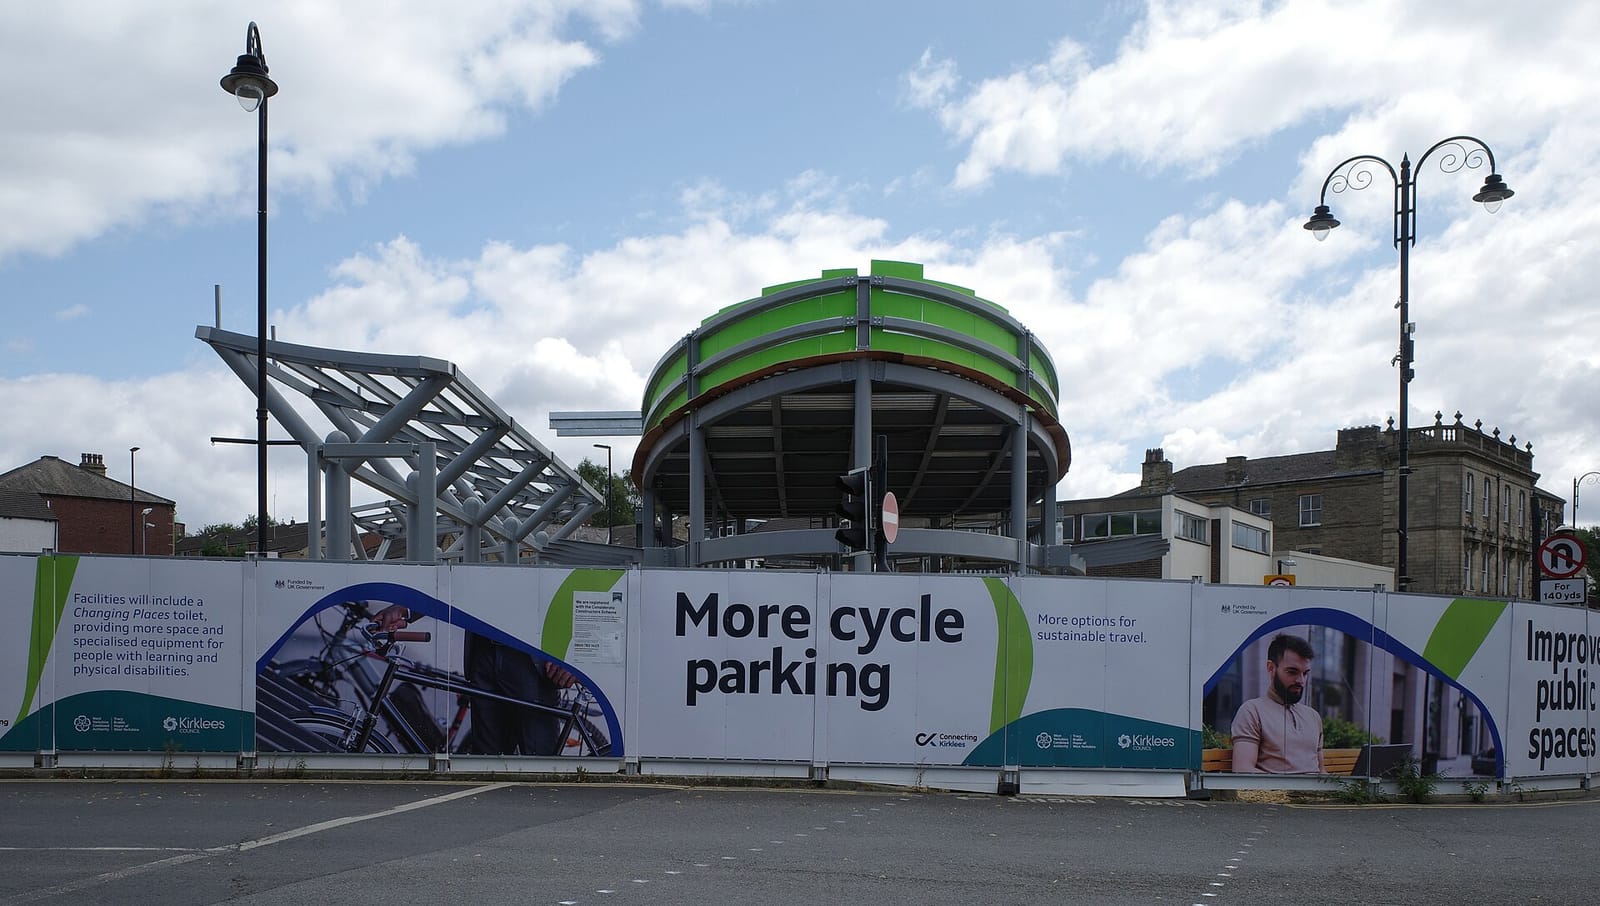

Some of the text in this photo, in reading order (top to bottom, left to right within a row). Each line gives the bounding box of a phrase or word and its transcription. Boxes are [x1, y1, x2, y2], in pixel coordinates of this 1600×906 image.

[74, 593, 204, 607] Facilities will include a
[1544, 592, 1581, 600] 140 yds
[73, 607, 207, 622] Changing Places toilet,
[1038, 614, 1137, 628] More options for
[73, 622, 224, 636] providing more space and
[675, 592, 965, 655] More cycle
[73, 636, 224, 650] specialised equipment for
[1037, 630, 1147, 643] sustainable travel.
[73, 650, 218, 665] people with learning and
[73, 664, 189, 676] physical disabilities.
[686, 646, 891, 712] parking
[1536, 667, 1596, 722] public
[179, 717, 225, 729] Kirklees
[939, 733, 978, 742] Connecting
[1132, 734, 1175, 747] Kirklees
[1528, 726, 1596, 771] spaces
